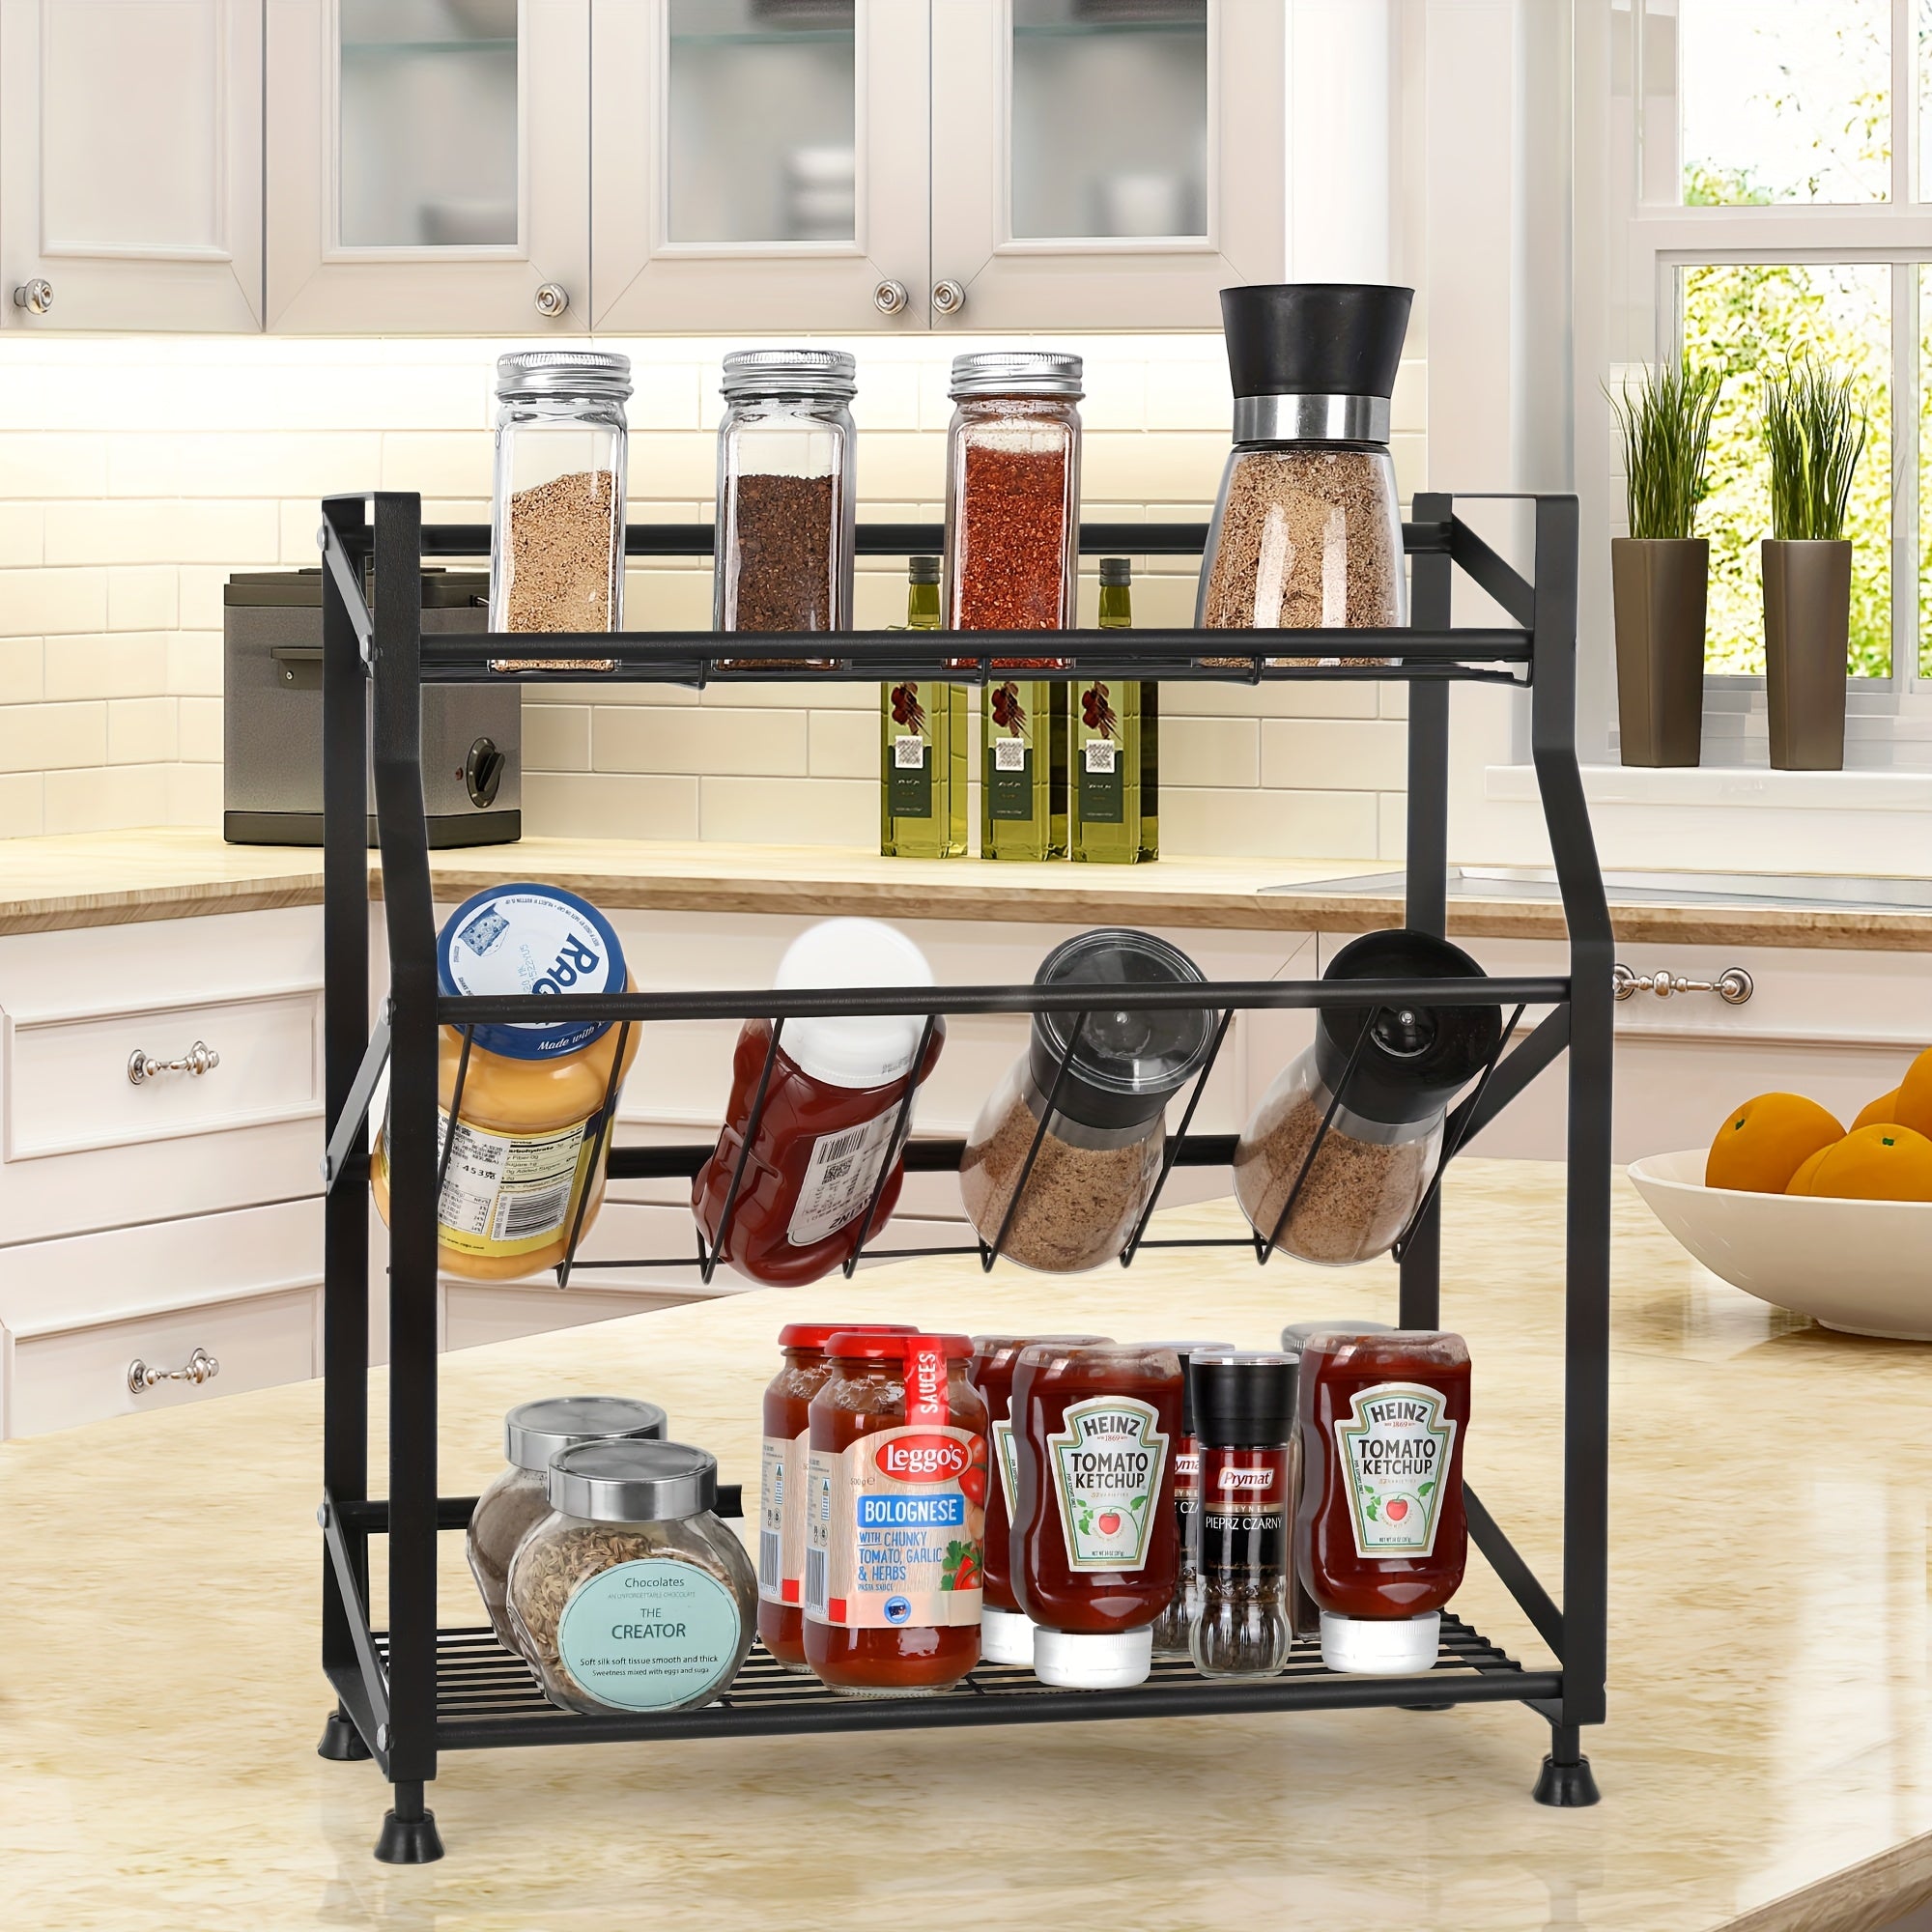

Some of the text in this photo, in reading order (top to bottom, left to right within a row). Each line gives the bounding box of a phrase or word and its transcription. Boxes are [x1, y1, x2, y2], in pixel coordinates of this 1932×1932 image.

[537, 1025, 594, 1050] Made with
[918, 1353, 938, 1414] SAUCES
[1371, 1402, 1428, 1423] HEINZ
[1083, 1416, 1140, 1437] HEINZ
[1359, 1439, 1436, 1458] TOMATO
[887, 1444, 962, 1473] Leggo's
[1071, 1453, 1148, 1472] TOMATO
[1363, 1459, 1432, 1475] KETCHUP
[1076, 1473, 1145, 1489] KETCHUP
[1224, 1472, 1270, 1487] Prymat
[865, 1499, 957, 1522] BOLOGNESE
[1206, 1516, 1282, 1530] PIEPRZ CZARNY
[859, 1531, 927, 1546] WITH CHUNKY
[859, 1548, 942, 1565] TOMATO, GARLIC
[858, 1566, 906, 1581] & HERBS
[625, 1577, 684, 1588] Chocolates
[640, 1608, 661, 1618] THE
[612, 1623, 686, 1639] CREATOR
[580, 1657, 596, 1666] Soft
